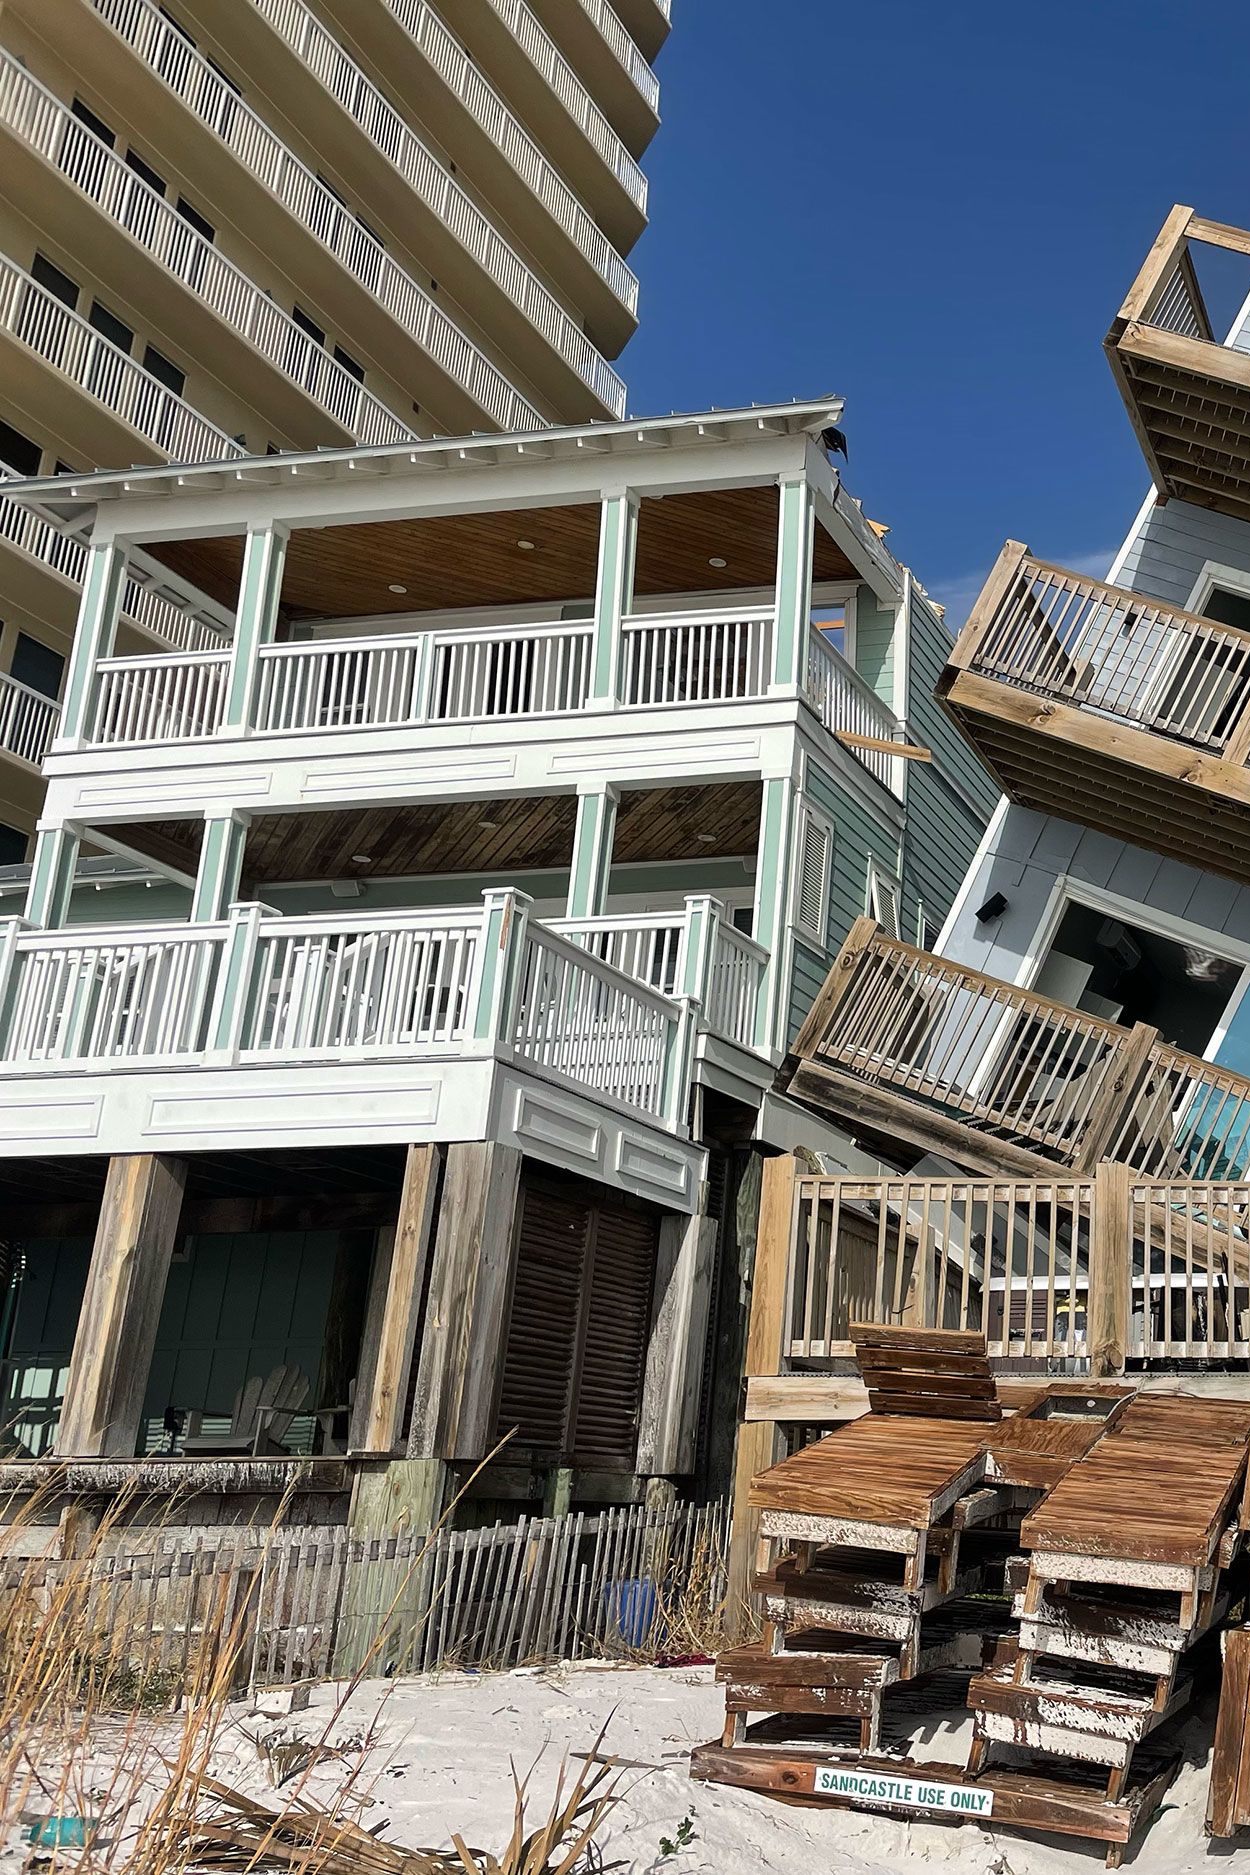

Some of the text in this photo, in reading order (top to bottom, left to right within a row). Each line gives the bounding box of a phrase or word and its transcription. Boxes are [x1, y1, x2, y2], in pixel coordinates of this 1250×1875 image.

[821, 1772, 986, 1811] SANDCASTLE USE ONLY
